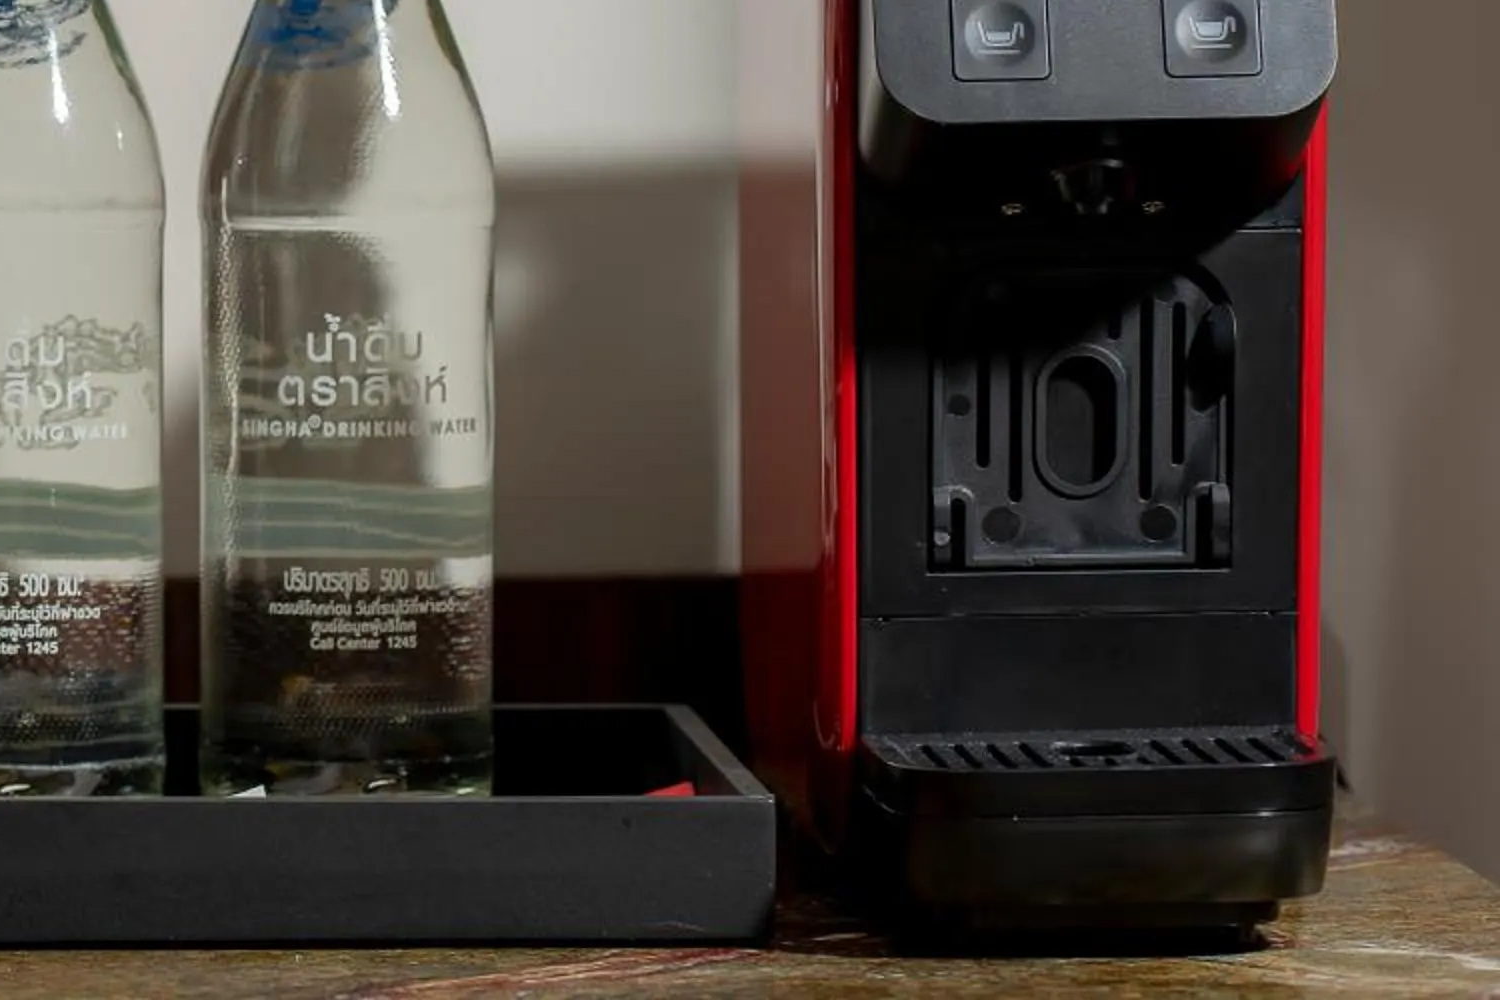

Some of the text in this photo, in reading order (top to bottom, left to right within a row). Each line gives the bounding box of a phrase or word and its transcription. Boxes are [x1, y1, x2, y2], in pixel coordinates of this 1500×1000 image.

[277, 365, 448, 406] ตราสิงห์
[323, 420, 421, 438] DRINKING
[428, 417, 477, 435] WATER
[18, 573, 49, 597] 500
[379, 568, 409, 591] 500
[26, 640, 59, 654] 1245
[309, 636, 417, 651] Call Center 1245
